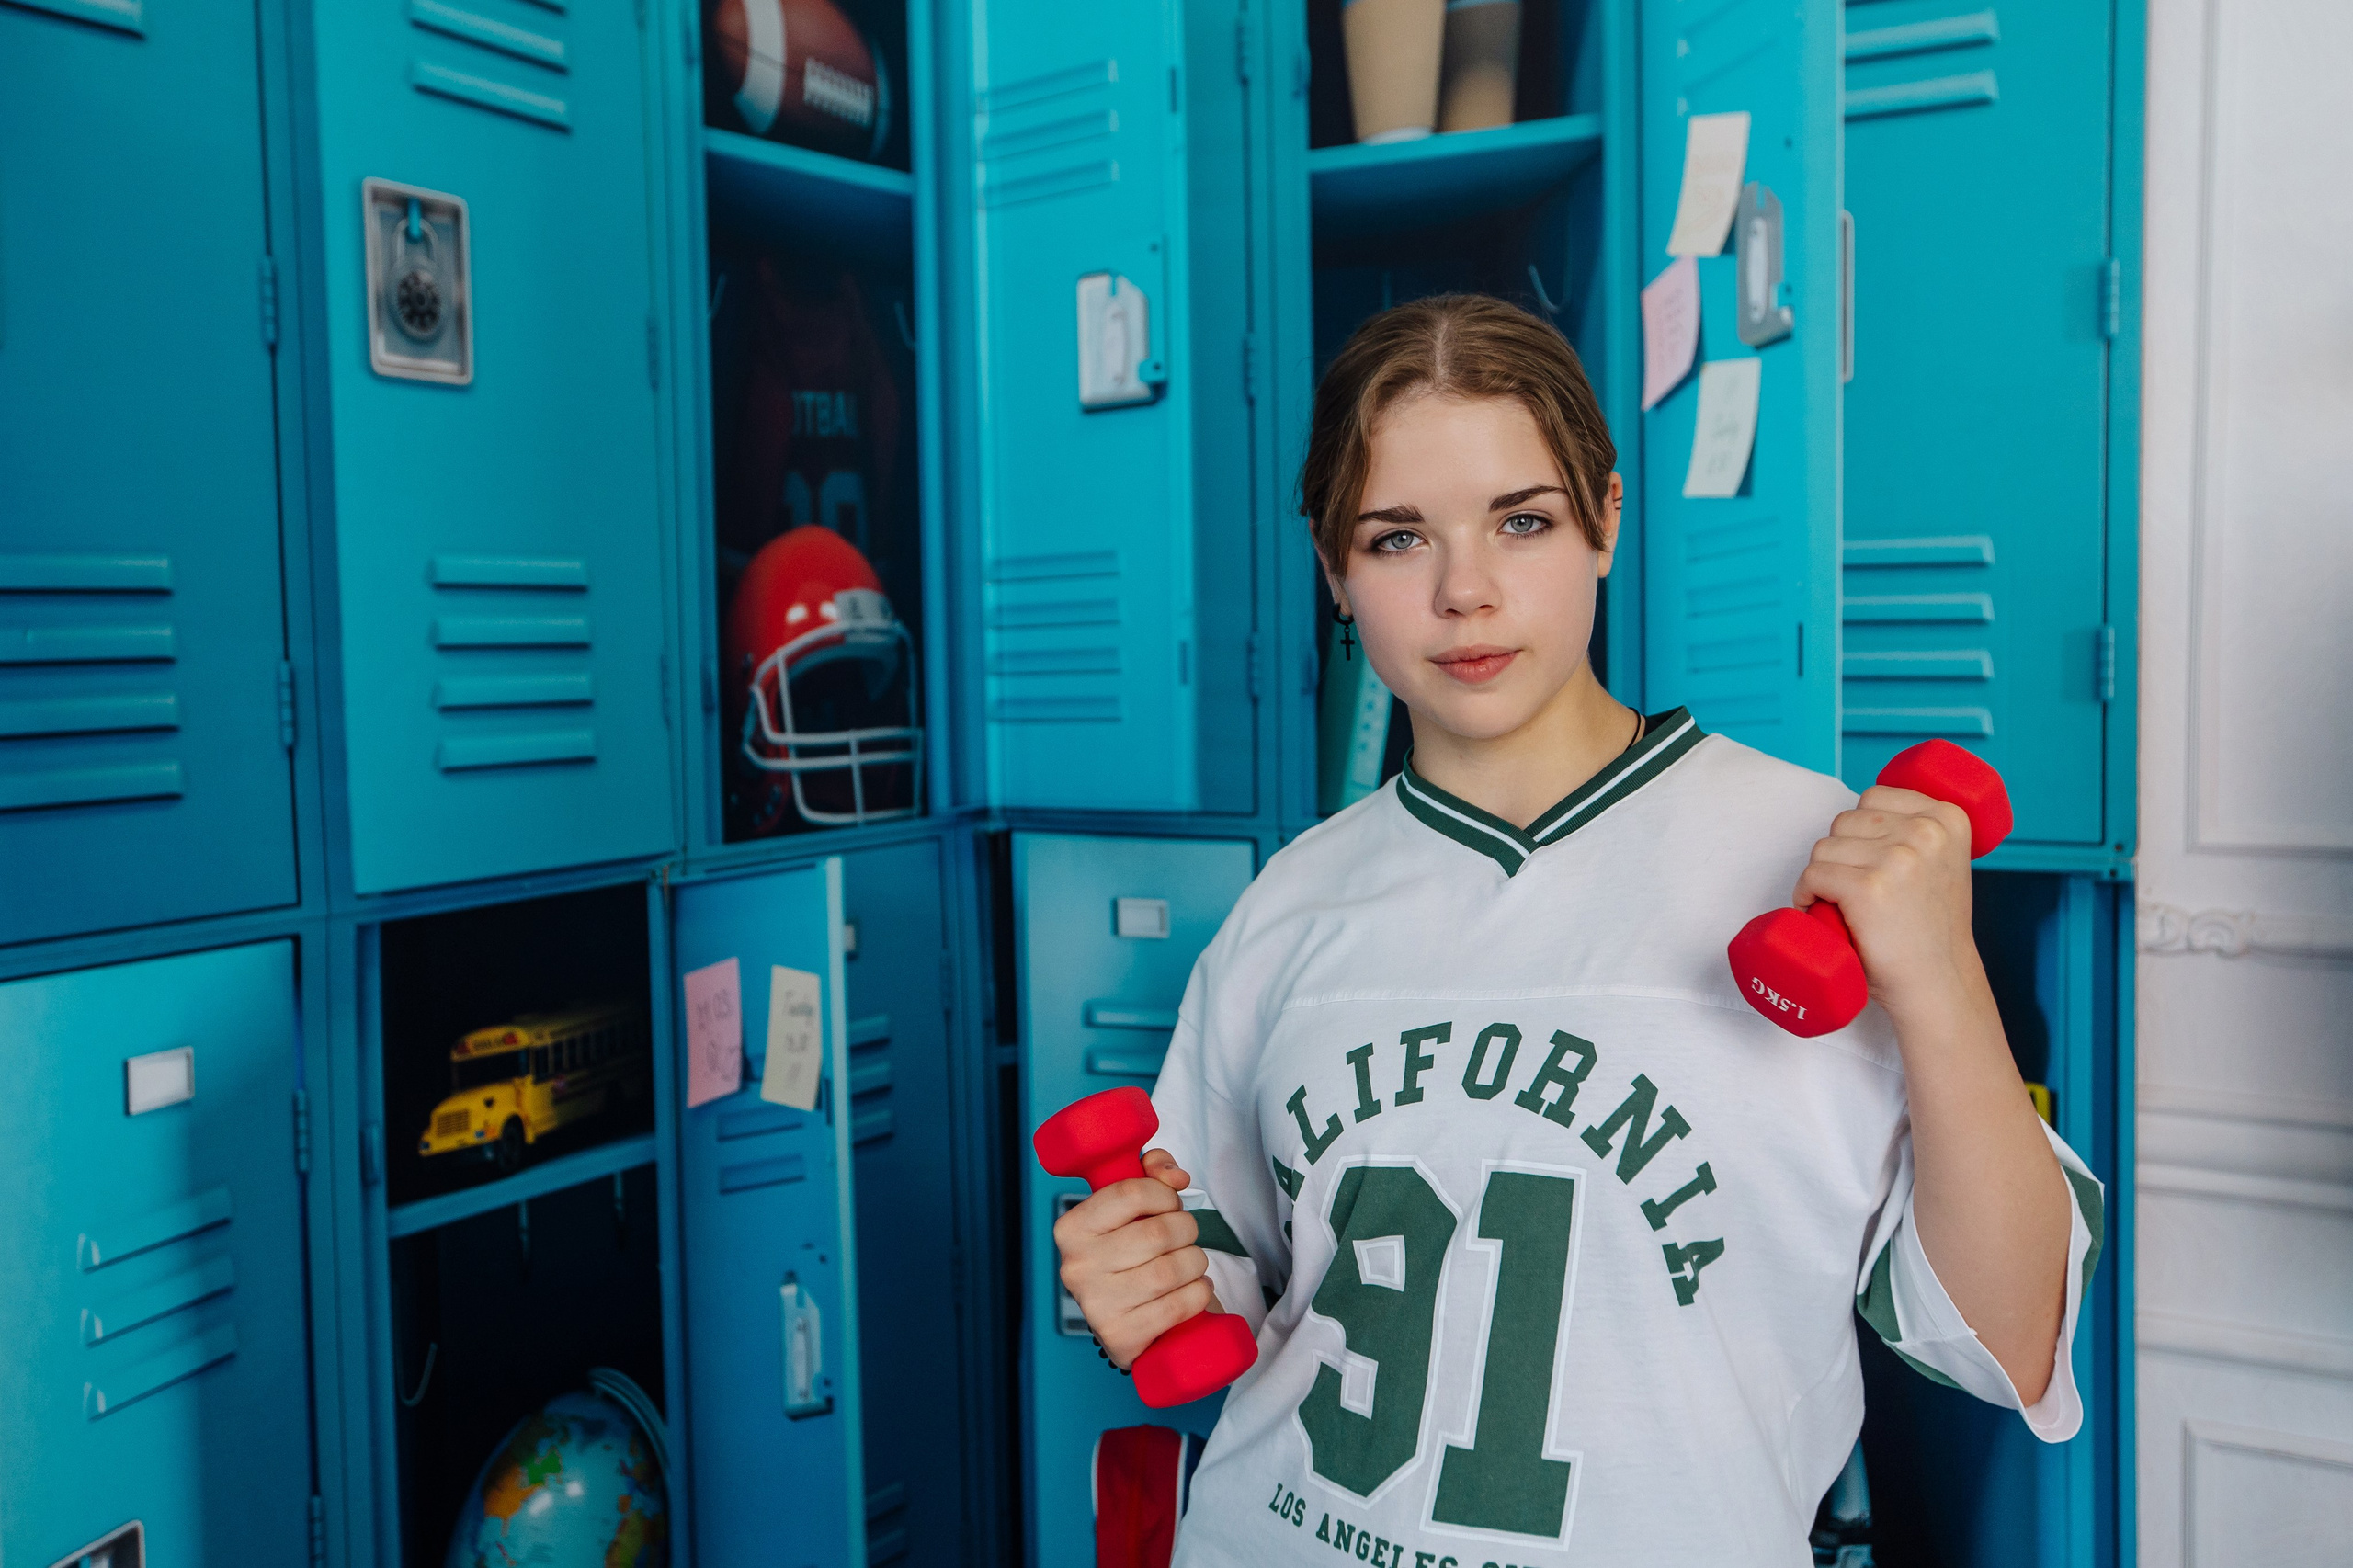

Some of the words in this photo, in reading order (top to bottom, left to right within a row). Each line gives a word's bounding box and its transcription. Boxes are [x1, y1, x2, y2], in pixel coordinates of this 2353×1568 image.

[1751, 976, 1808, 1020] 1.5KG
[1271, 1021, 1725, 1306] ALIFORNIA
[1292, 1154, 1587, 1552] 91
[1268, 1483, 1306, 1528] LOS
